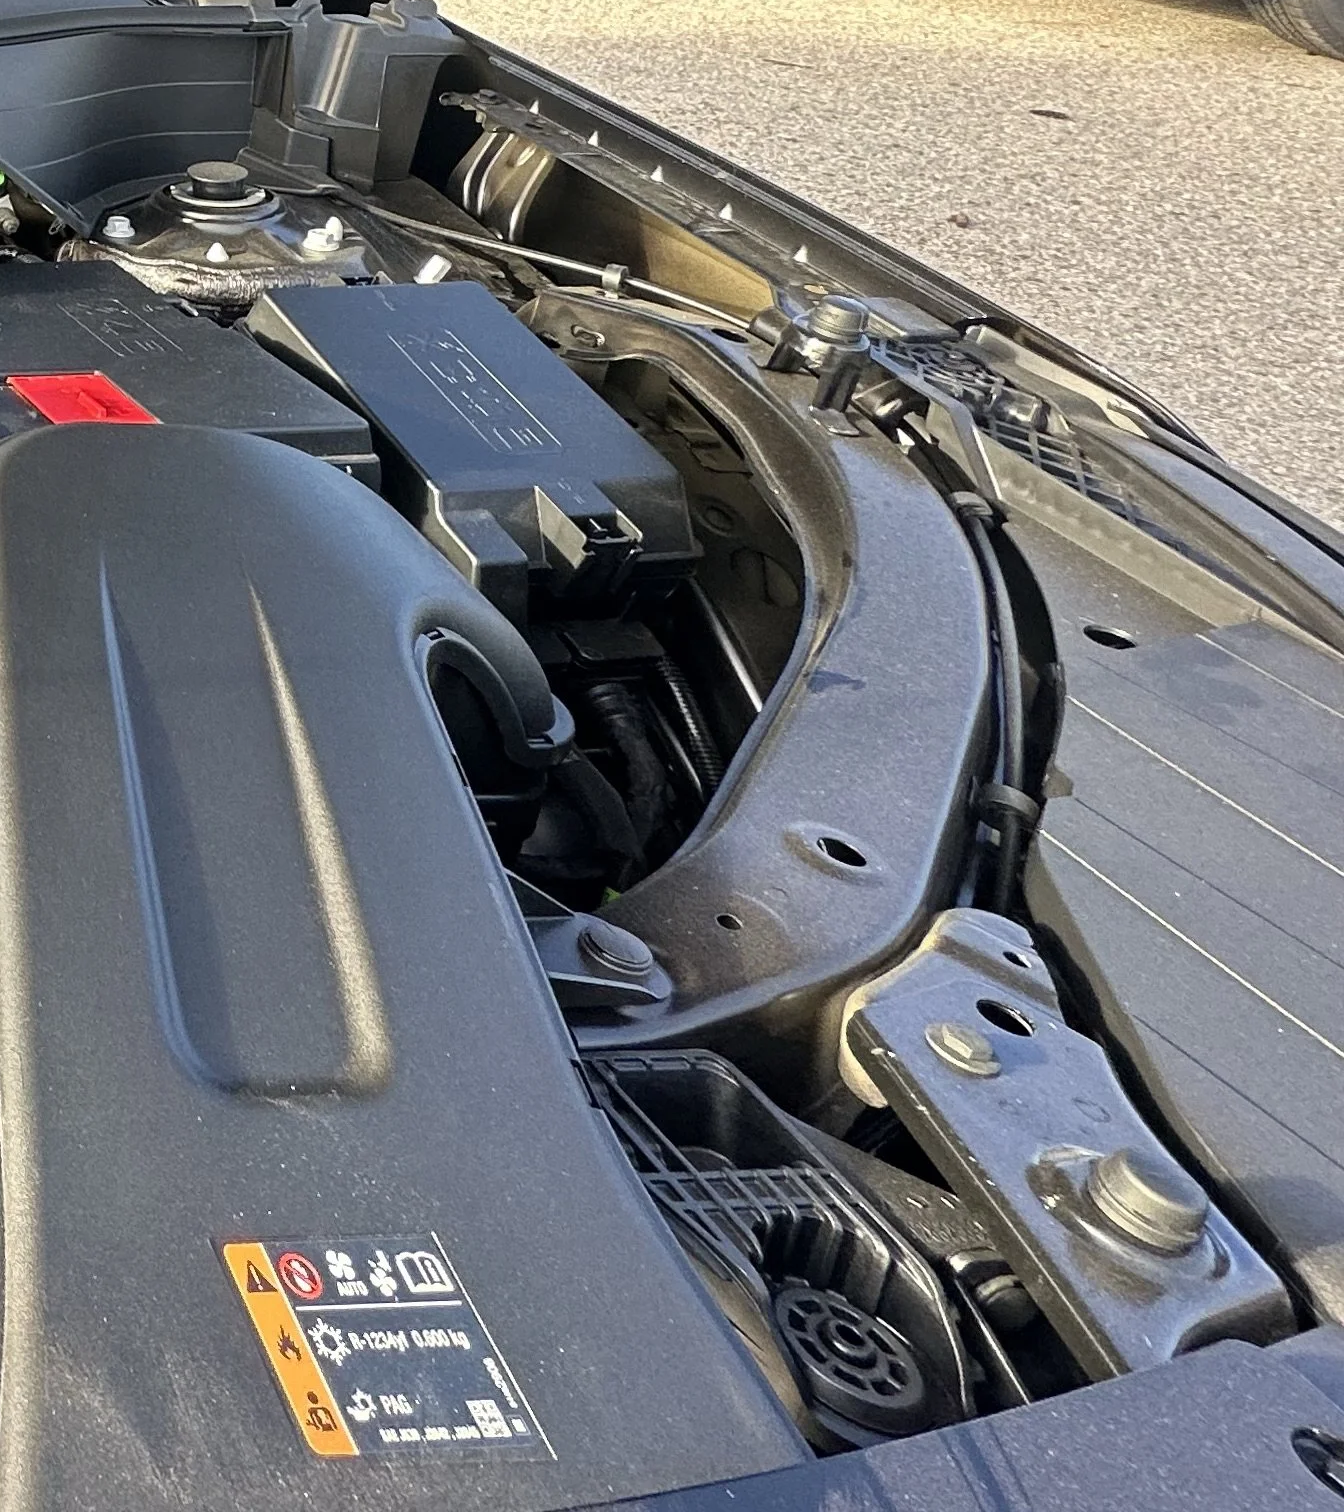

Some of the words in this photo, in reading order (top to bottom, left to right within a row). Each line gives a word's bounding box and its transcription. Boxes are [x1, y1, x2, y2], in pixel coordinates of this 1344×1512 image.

[336, 1280, 369, 1297] AUTO
[347, 1330, 410, 1352] R-1234yf
[410, 1328, 452, 1348] 0.600
[447, 1328, 471, 1350] kg
[378, 1393, 414, 1416] PAG
